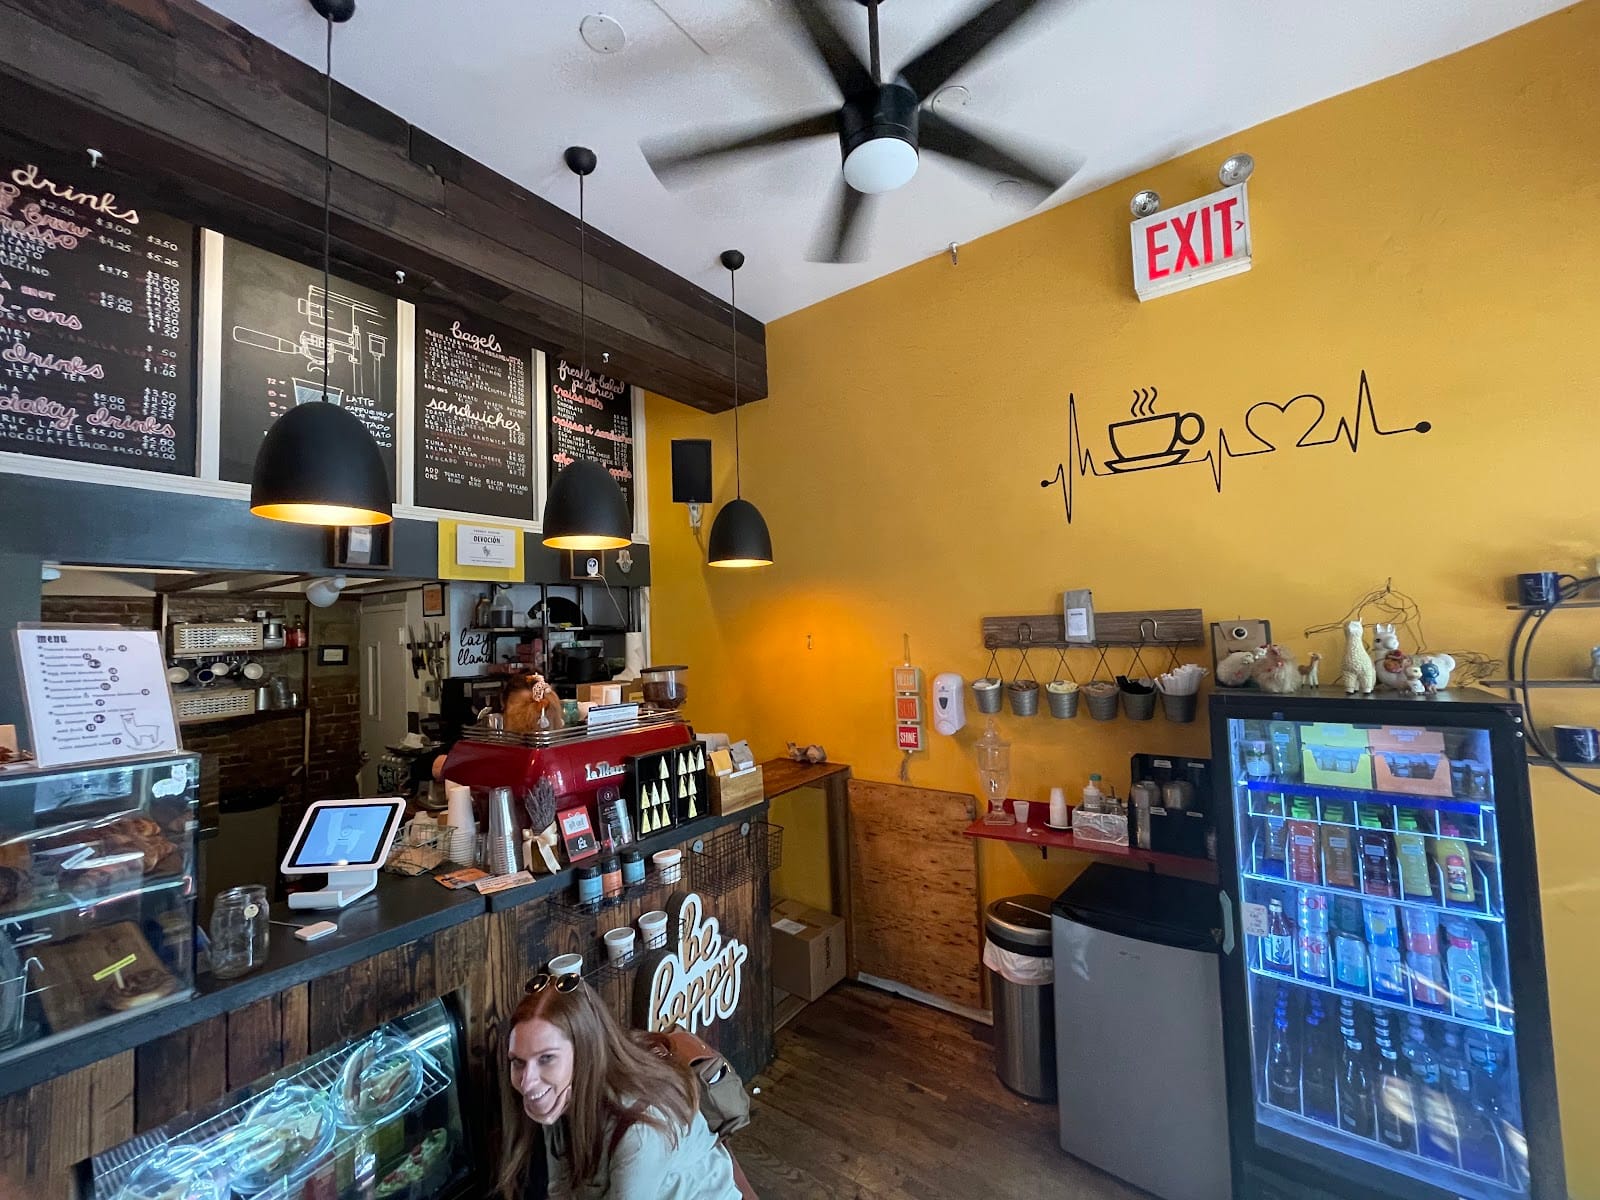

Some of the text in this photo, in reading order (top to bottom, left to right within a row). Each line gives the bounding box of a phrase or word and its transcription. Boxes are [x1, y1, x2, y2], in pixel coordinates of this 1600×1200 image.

[11, 164, 139, 225] drinks
[96, 217, 178, 251] $3.00 $3.50
[1145, 197, 1238, 281] EXIT
[146, 251, 179, 268] $5.25
[449, 320, 502, 353] bagels
[2, 343, 105, 379] drinks
[5, 368, 36, 381] TEA
[345, 395, 375, 407] LATTE
[426, 397, 520, 432] sandwiches
[27, 427, 85, 440] COFFEE
[39, 419, 83, 433] LATE
[86, 407, 176, 439] drinks
[424, 466, 439, 475] ADD
[473, 535, 501, 544] DEVOCIÓN
[36, 634, 68, 644] menu
[459, 627, 489, 656] lazy
[900, 732, 918, 745] SHINE
[679, 893, 721, 976] be
[649, 941, 748, 1034] happy
